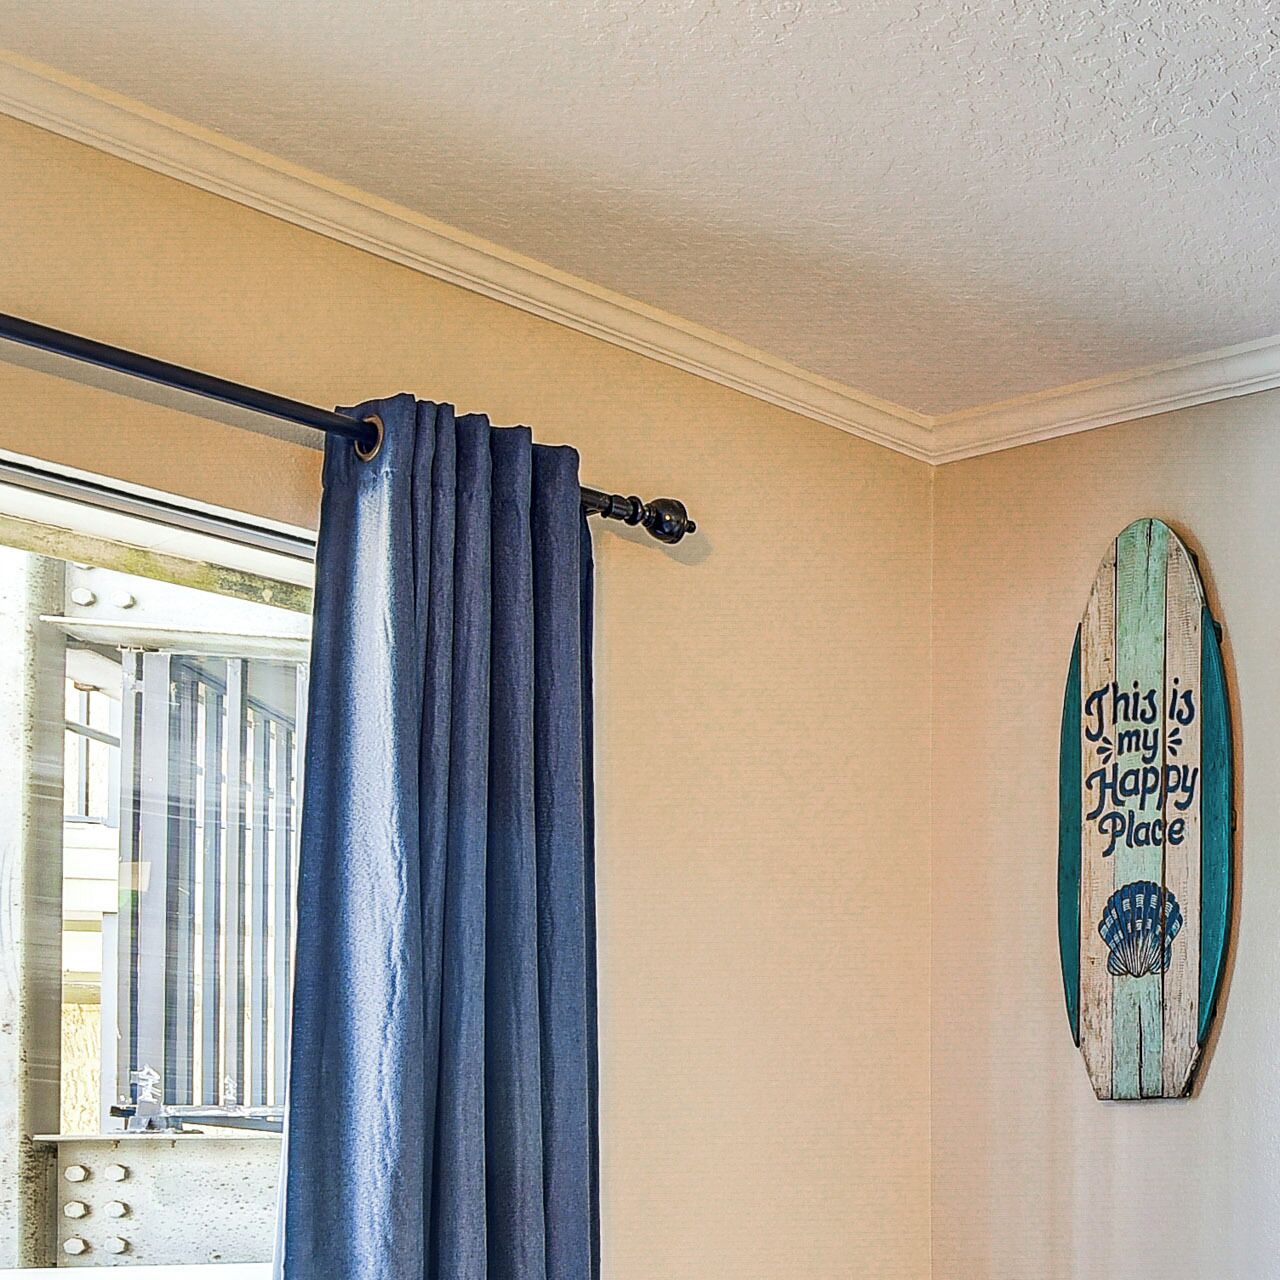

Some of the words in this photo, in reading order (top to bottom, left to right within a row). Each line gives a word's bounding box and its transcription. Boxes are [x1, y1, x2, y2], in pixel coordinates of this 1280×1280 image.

[1085, 680, 1160, 742] This
[1169, 677, 1195, 725] is
[1116, 729, 1160, 767] my
[1085, 763, 1199, 820] Happy
[1099, 811, 1186, 857] Place
